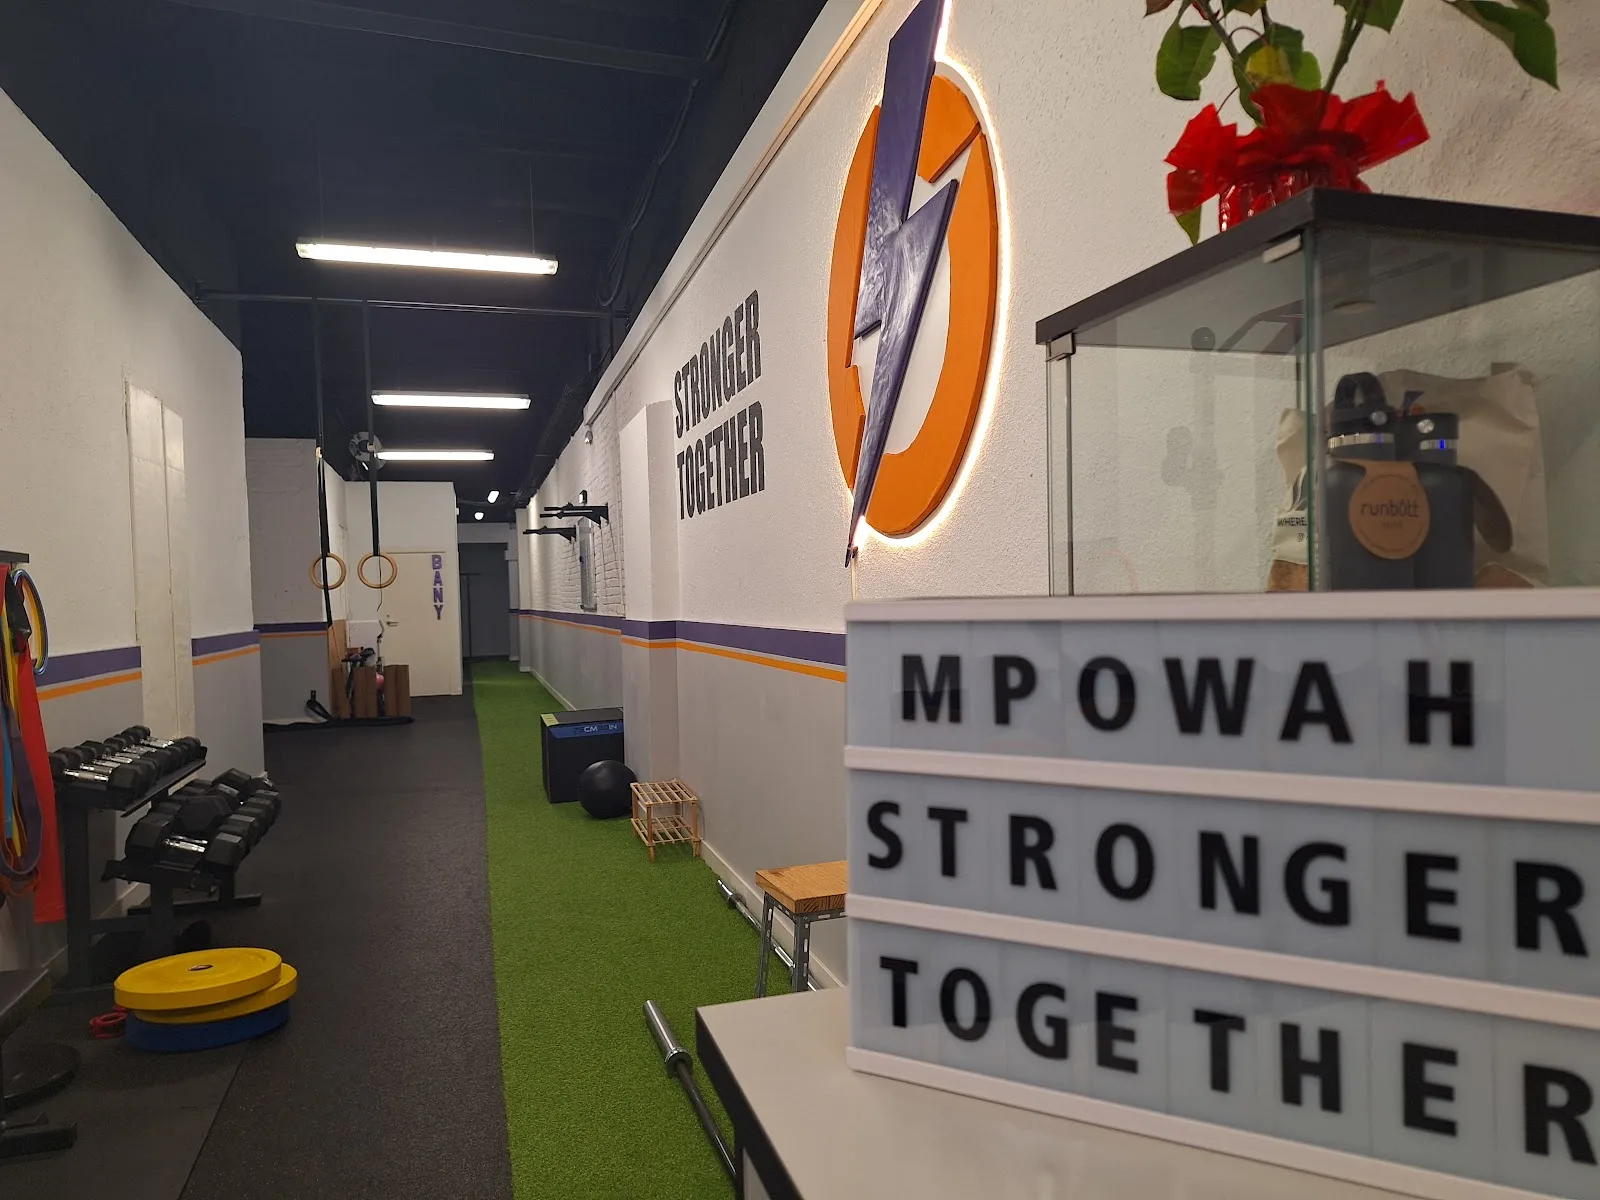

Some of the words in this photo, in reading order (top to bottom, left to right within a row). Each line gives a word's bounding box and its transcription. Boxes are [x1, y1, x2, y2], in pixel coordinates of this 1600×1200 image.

[674, 289, 762, 439] STRONGER
[676, 400, 765, 520] TOGETHER
[431, 554, 444, 621] BANY
[901, 654, 1476, 747] MPOWAH
[866, 800, 1589, 957] STRONGER
[879, 956, 1599, 1166] TOGETHER
